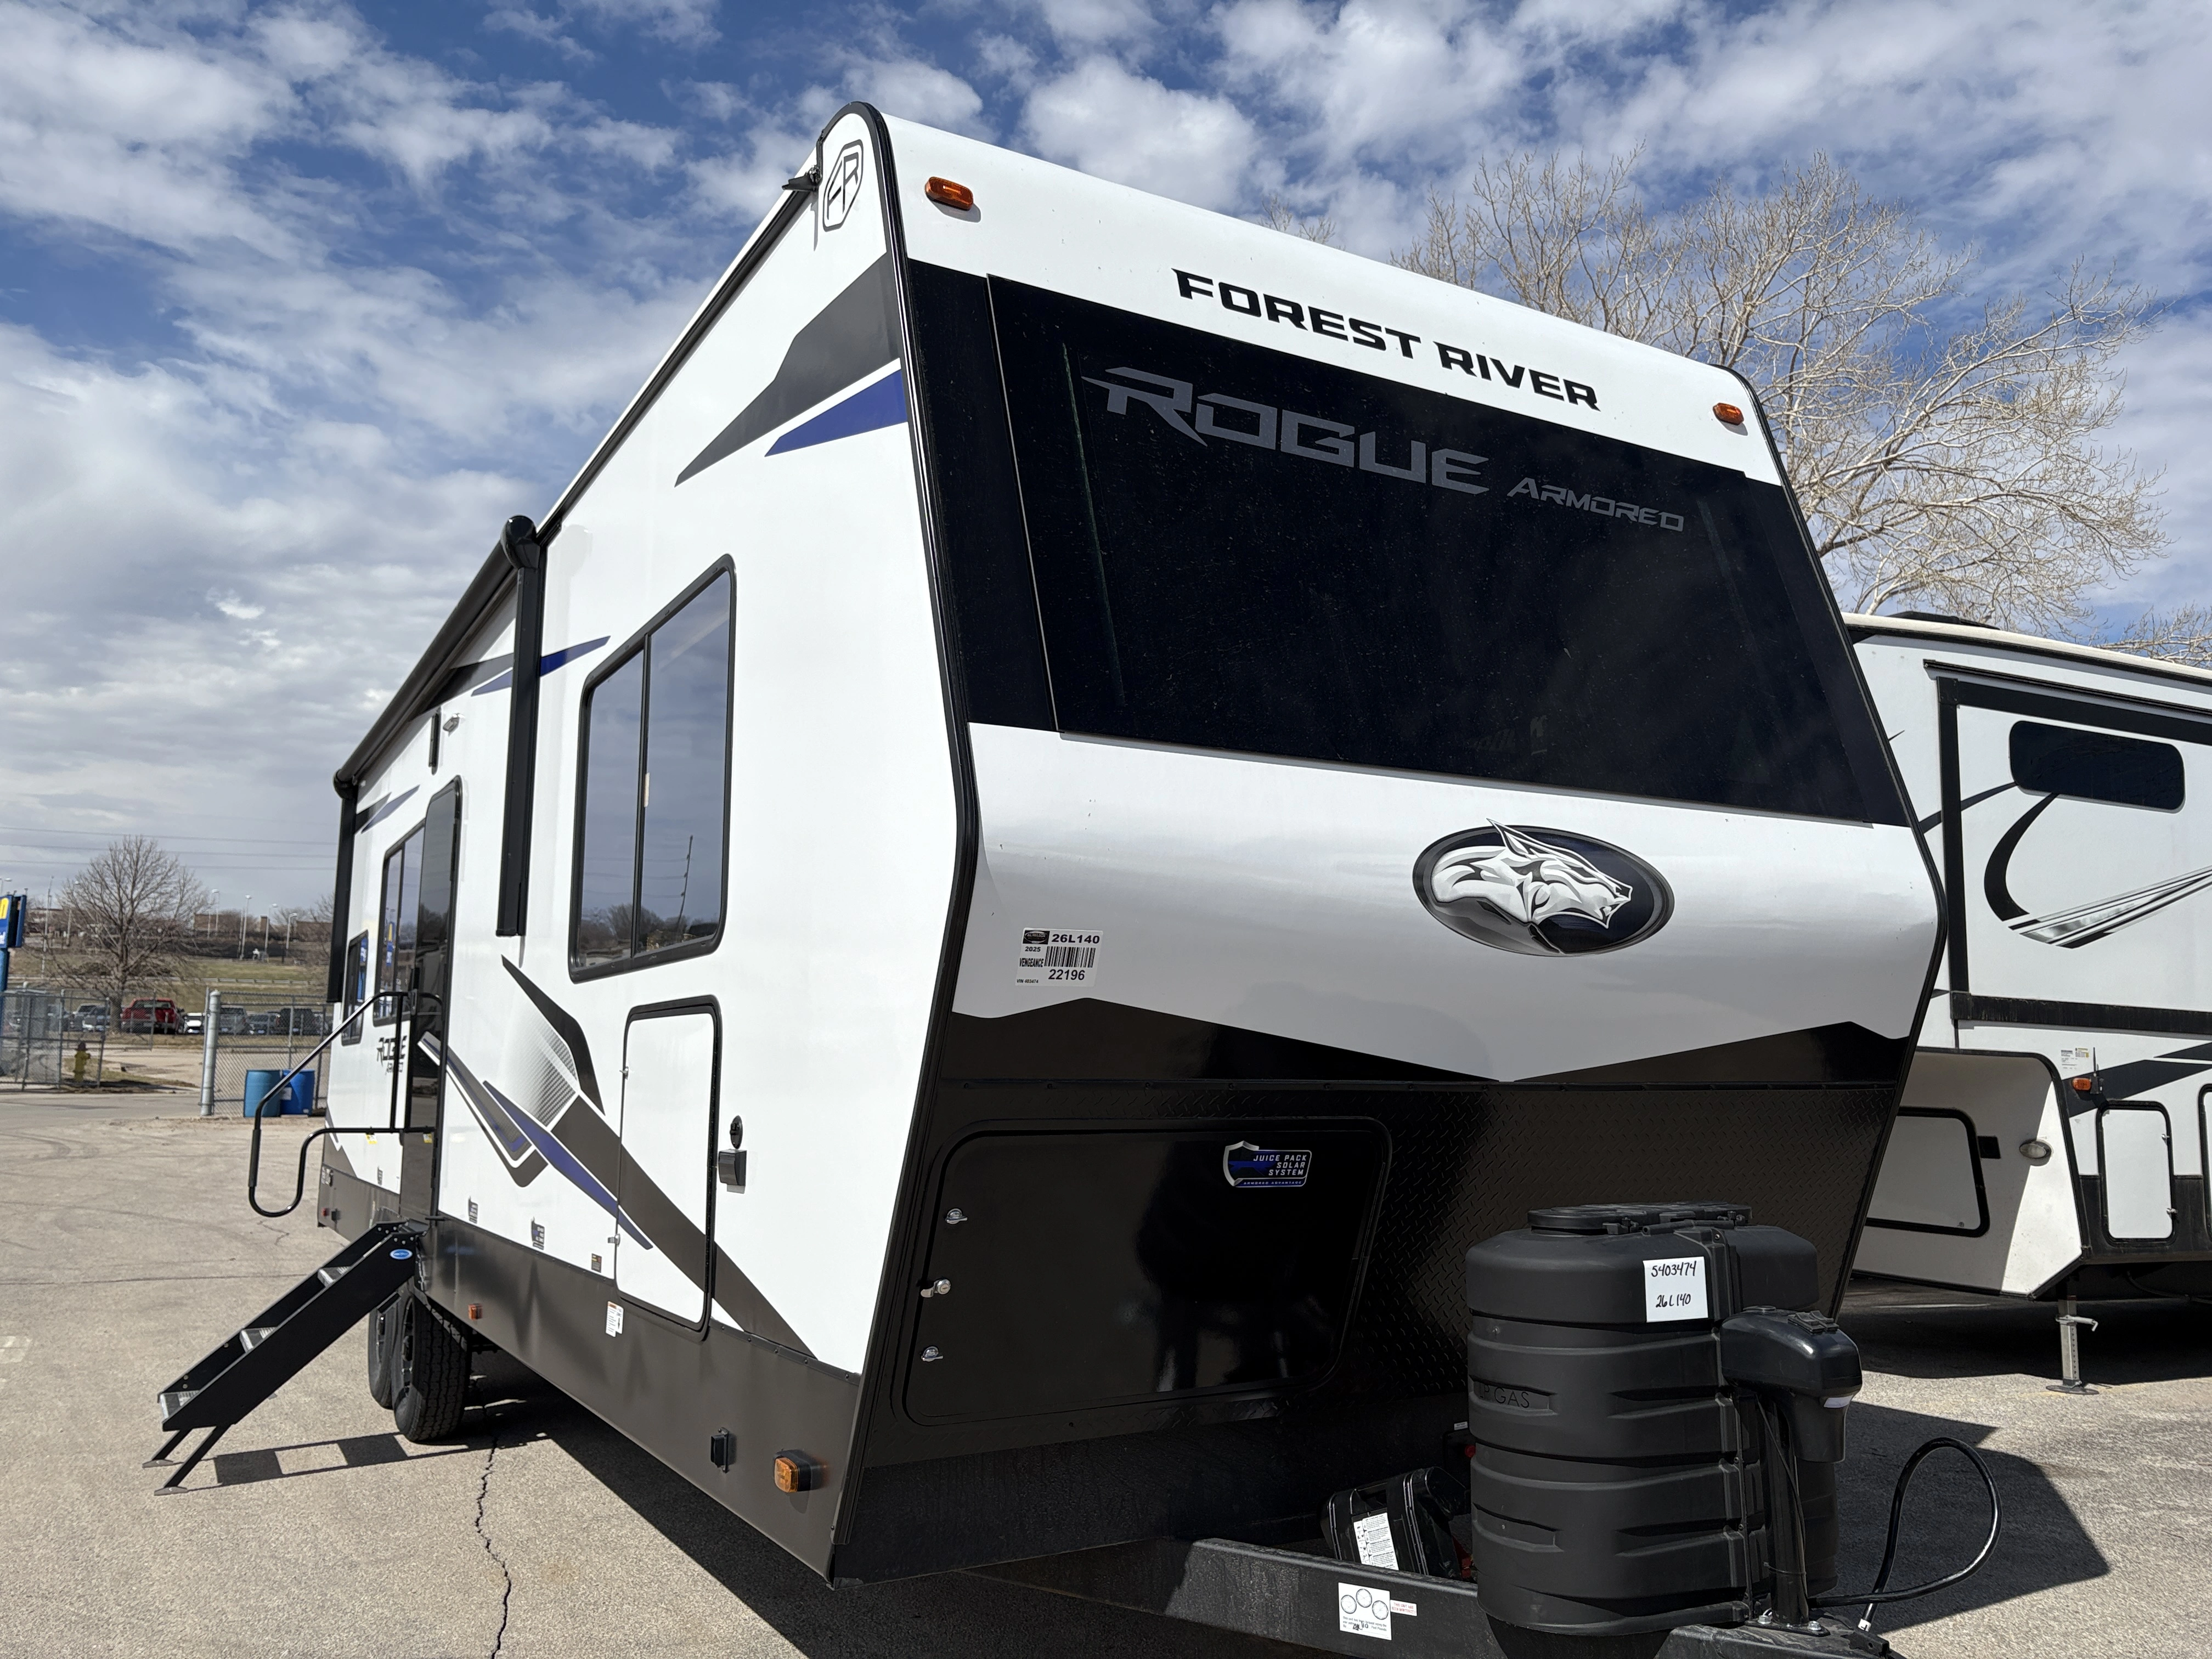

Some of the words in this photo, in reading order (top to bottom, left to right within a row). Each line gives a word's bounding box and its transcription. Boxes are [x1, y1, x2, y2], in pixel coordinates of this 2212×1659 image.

[1171, 267, 1421, 359] FOREST
[1432, 341, 1601, 412] RIVER
[1081, 366, 1489, 494] ROGUE
[1507, 477, 1684, 532] ARMORED
[1051, 934, 1101, 944] 26L140
[1019, 957, 1045, 968] VENGEANCE
[1048, 969, 1086, 981] 22196
[1494, 1387, 1530, 1409] GAS
